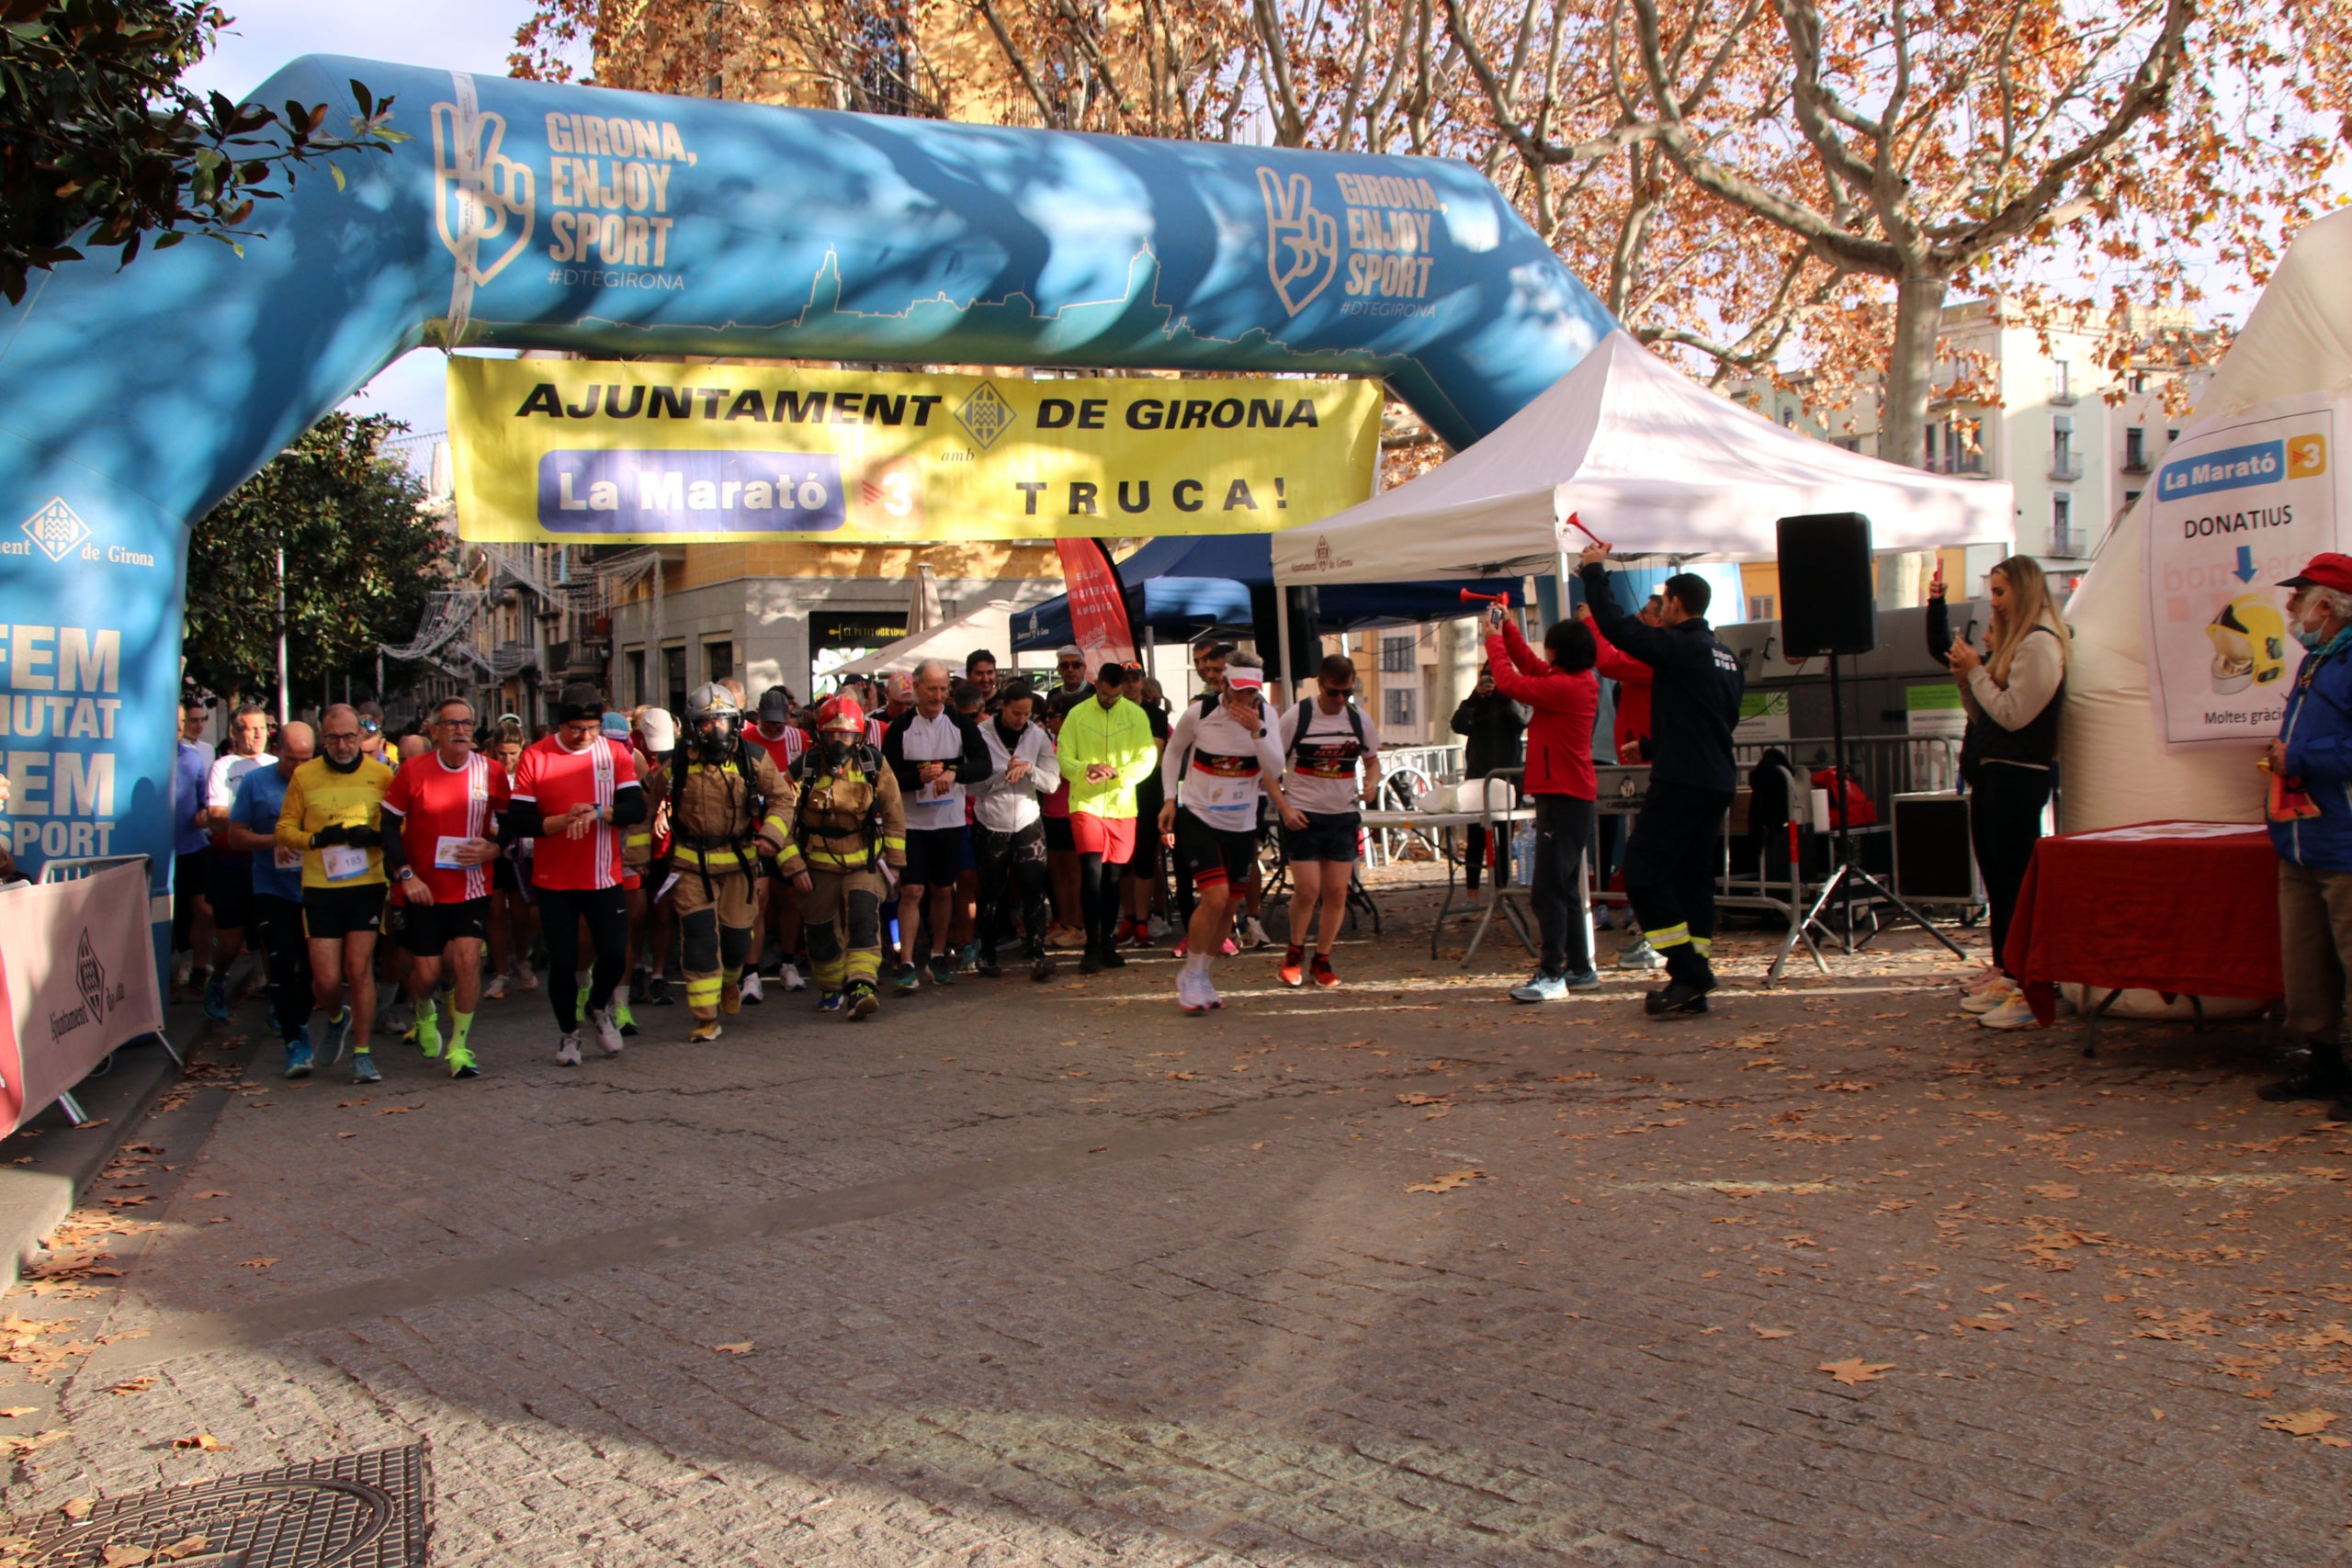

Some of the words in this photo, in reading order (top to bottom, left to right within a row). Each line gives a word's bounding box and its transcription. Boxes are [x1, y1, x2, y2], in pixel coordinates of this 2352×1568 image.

[546, 111, 698, 167] GIRONA,
[550, 156, 672, 212] ENJOY
[1335, 173, 1448, 215] GIRONA,
[548, 210, 673, 267] SPORT
[1346, 208, 1430, 253] ENJOY
[547, 269, 684, 290] #DTEGIRONA
[1345, 253, 1434, 299] SPORT
[1340, 301, 1436, 317] #DTEGIRONA
[514, 382, 943, 427] AJUNTAMENT
[1035, 398, 1108, 429] DE
[1125, 398, 1319, 430] GIRONA
[941, 448, 975, 462] amb
[2165, 472, 2188, 491] La
[2191, 452, 2278, 485] Marató
[2301, 443, 2321, 468] 3
[559, 472, 619, 511] La
[640, 471, 828, 511] Marató
[884, 471, 913, 516] 3
[1016, 477, 1287, 515] TRUCA!
[2185, 504, 2292, 538] DONATIUS
[81, 542, 100, 560] de
[107, 545, 154, 567] Girona
[0, 625, 120, 694] EM
[2204, 710, 2247, 724] Moltes
[2250, 707, 2287, 725] gràci
[0, 750, 115, 816] EM
[345, 854, 362, 868] 185
